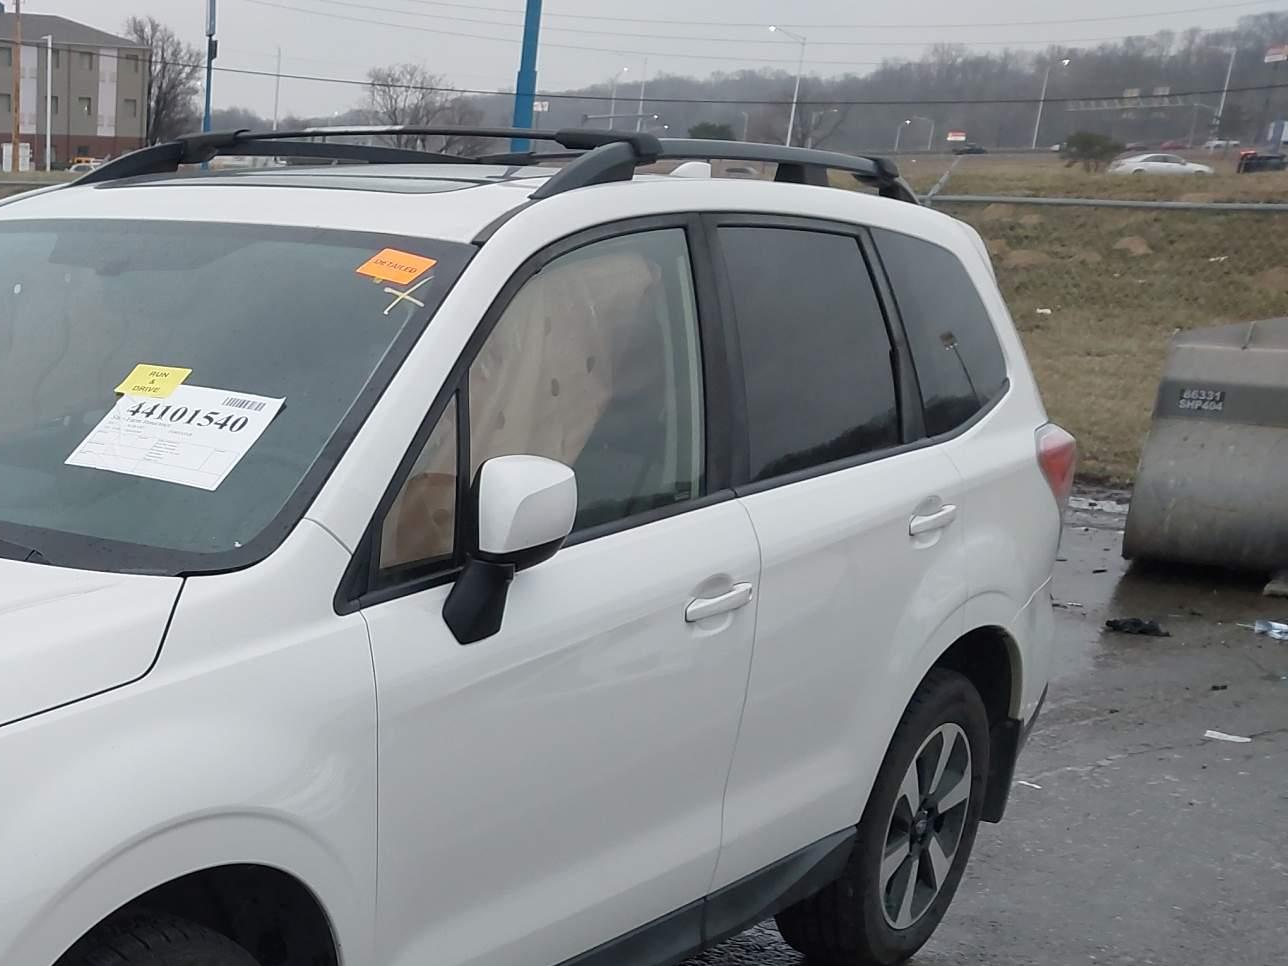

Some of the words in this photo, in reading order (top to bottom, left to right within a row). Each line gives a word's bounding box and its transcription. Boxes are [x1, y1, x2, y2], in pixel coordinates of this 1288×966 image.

[148, 370, 170, 378] RUN
[131, 385, 161, 393] DRIVE
[127, 401, 249, 433] 44101540
